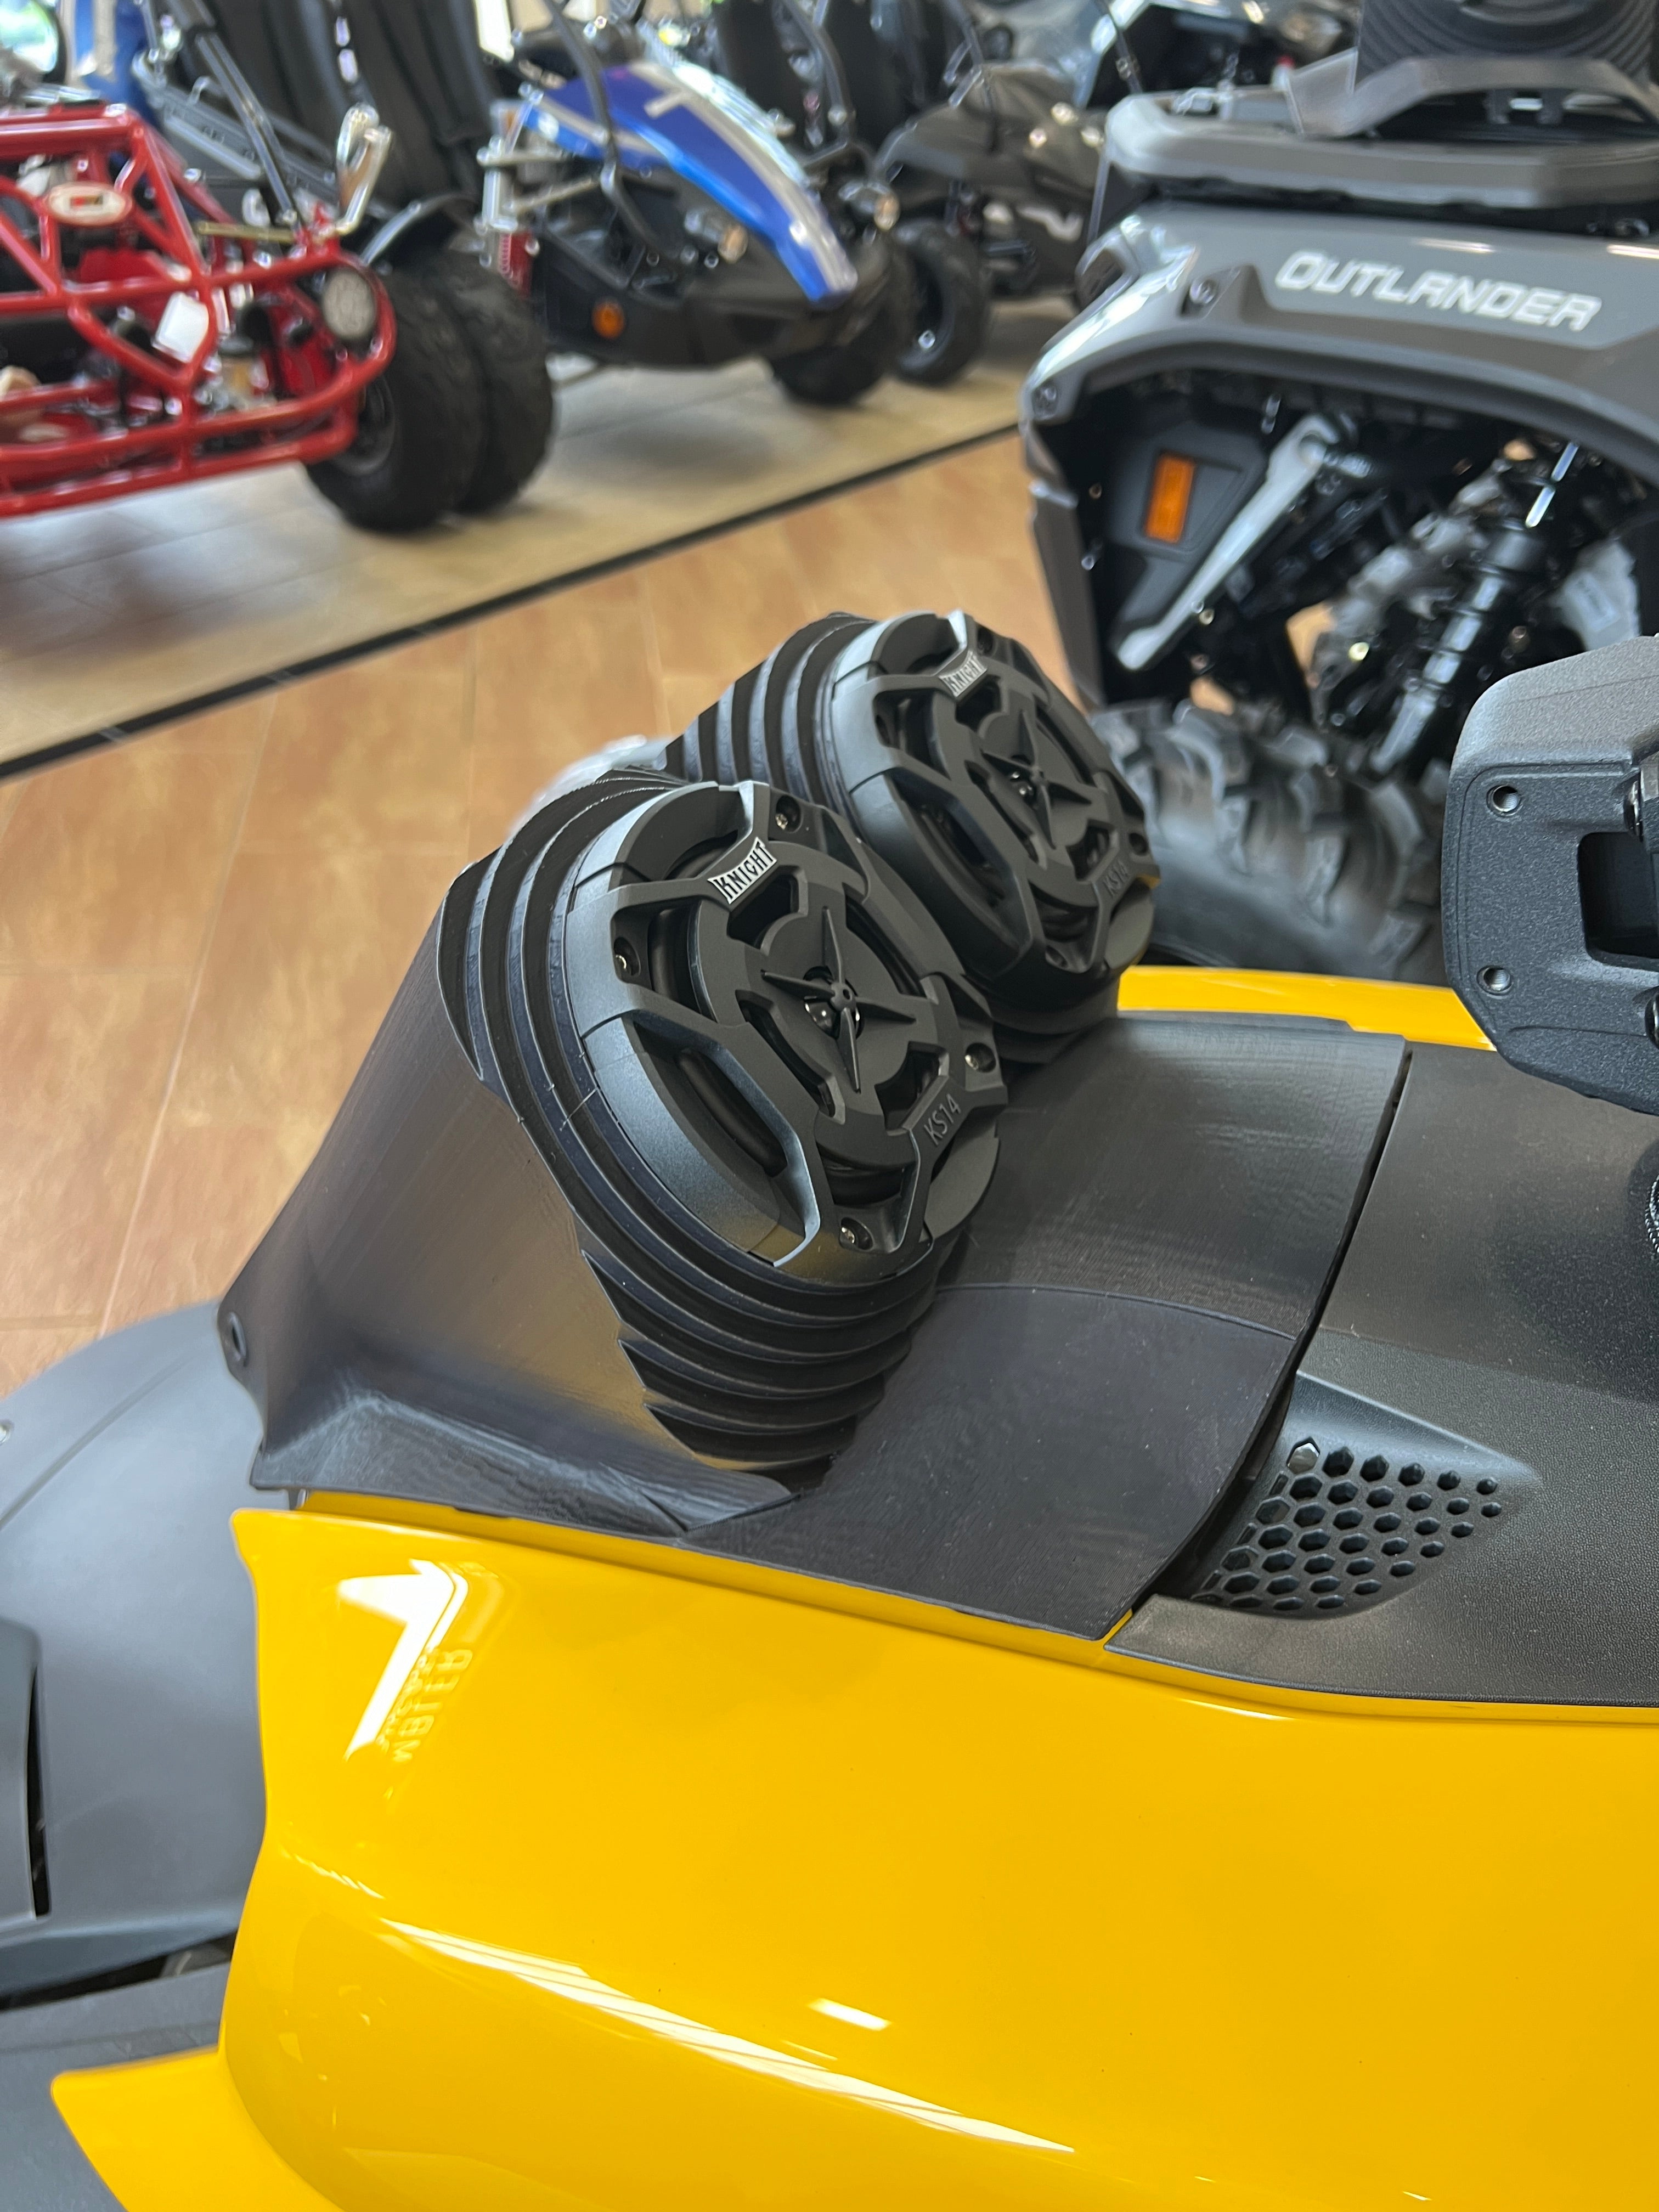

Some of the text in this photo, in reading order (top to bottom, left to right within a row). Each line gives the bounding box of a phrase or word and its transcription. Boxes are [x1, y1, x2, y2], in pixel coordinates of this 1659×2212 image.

[1275, 250, 1602, 332] OUTLANDER
[941, 651, 985, 695] KNIGHT
[712, 839, 774, 900] KNIGHT
[1102, 859, 1128, 899] KS14
[923, 1093, 961, 1146] KS14
